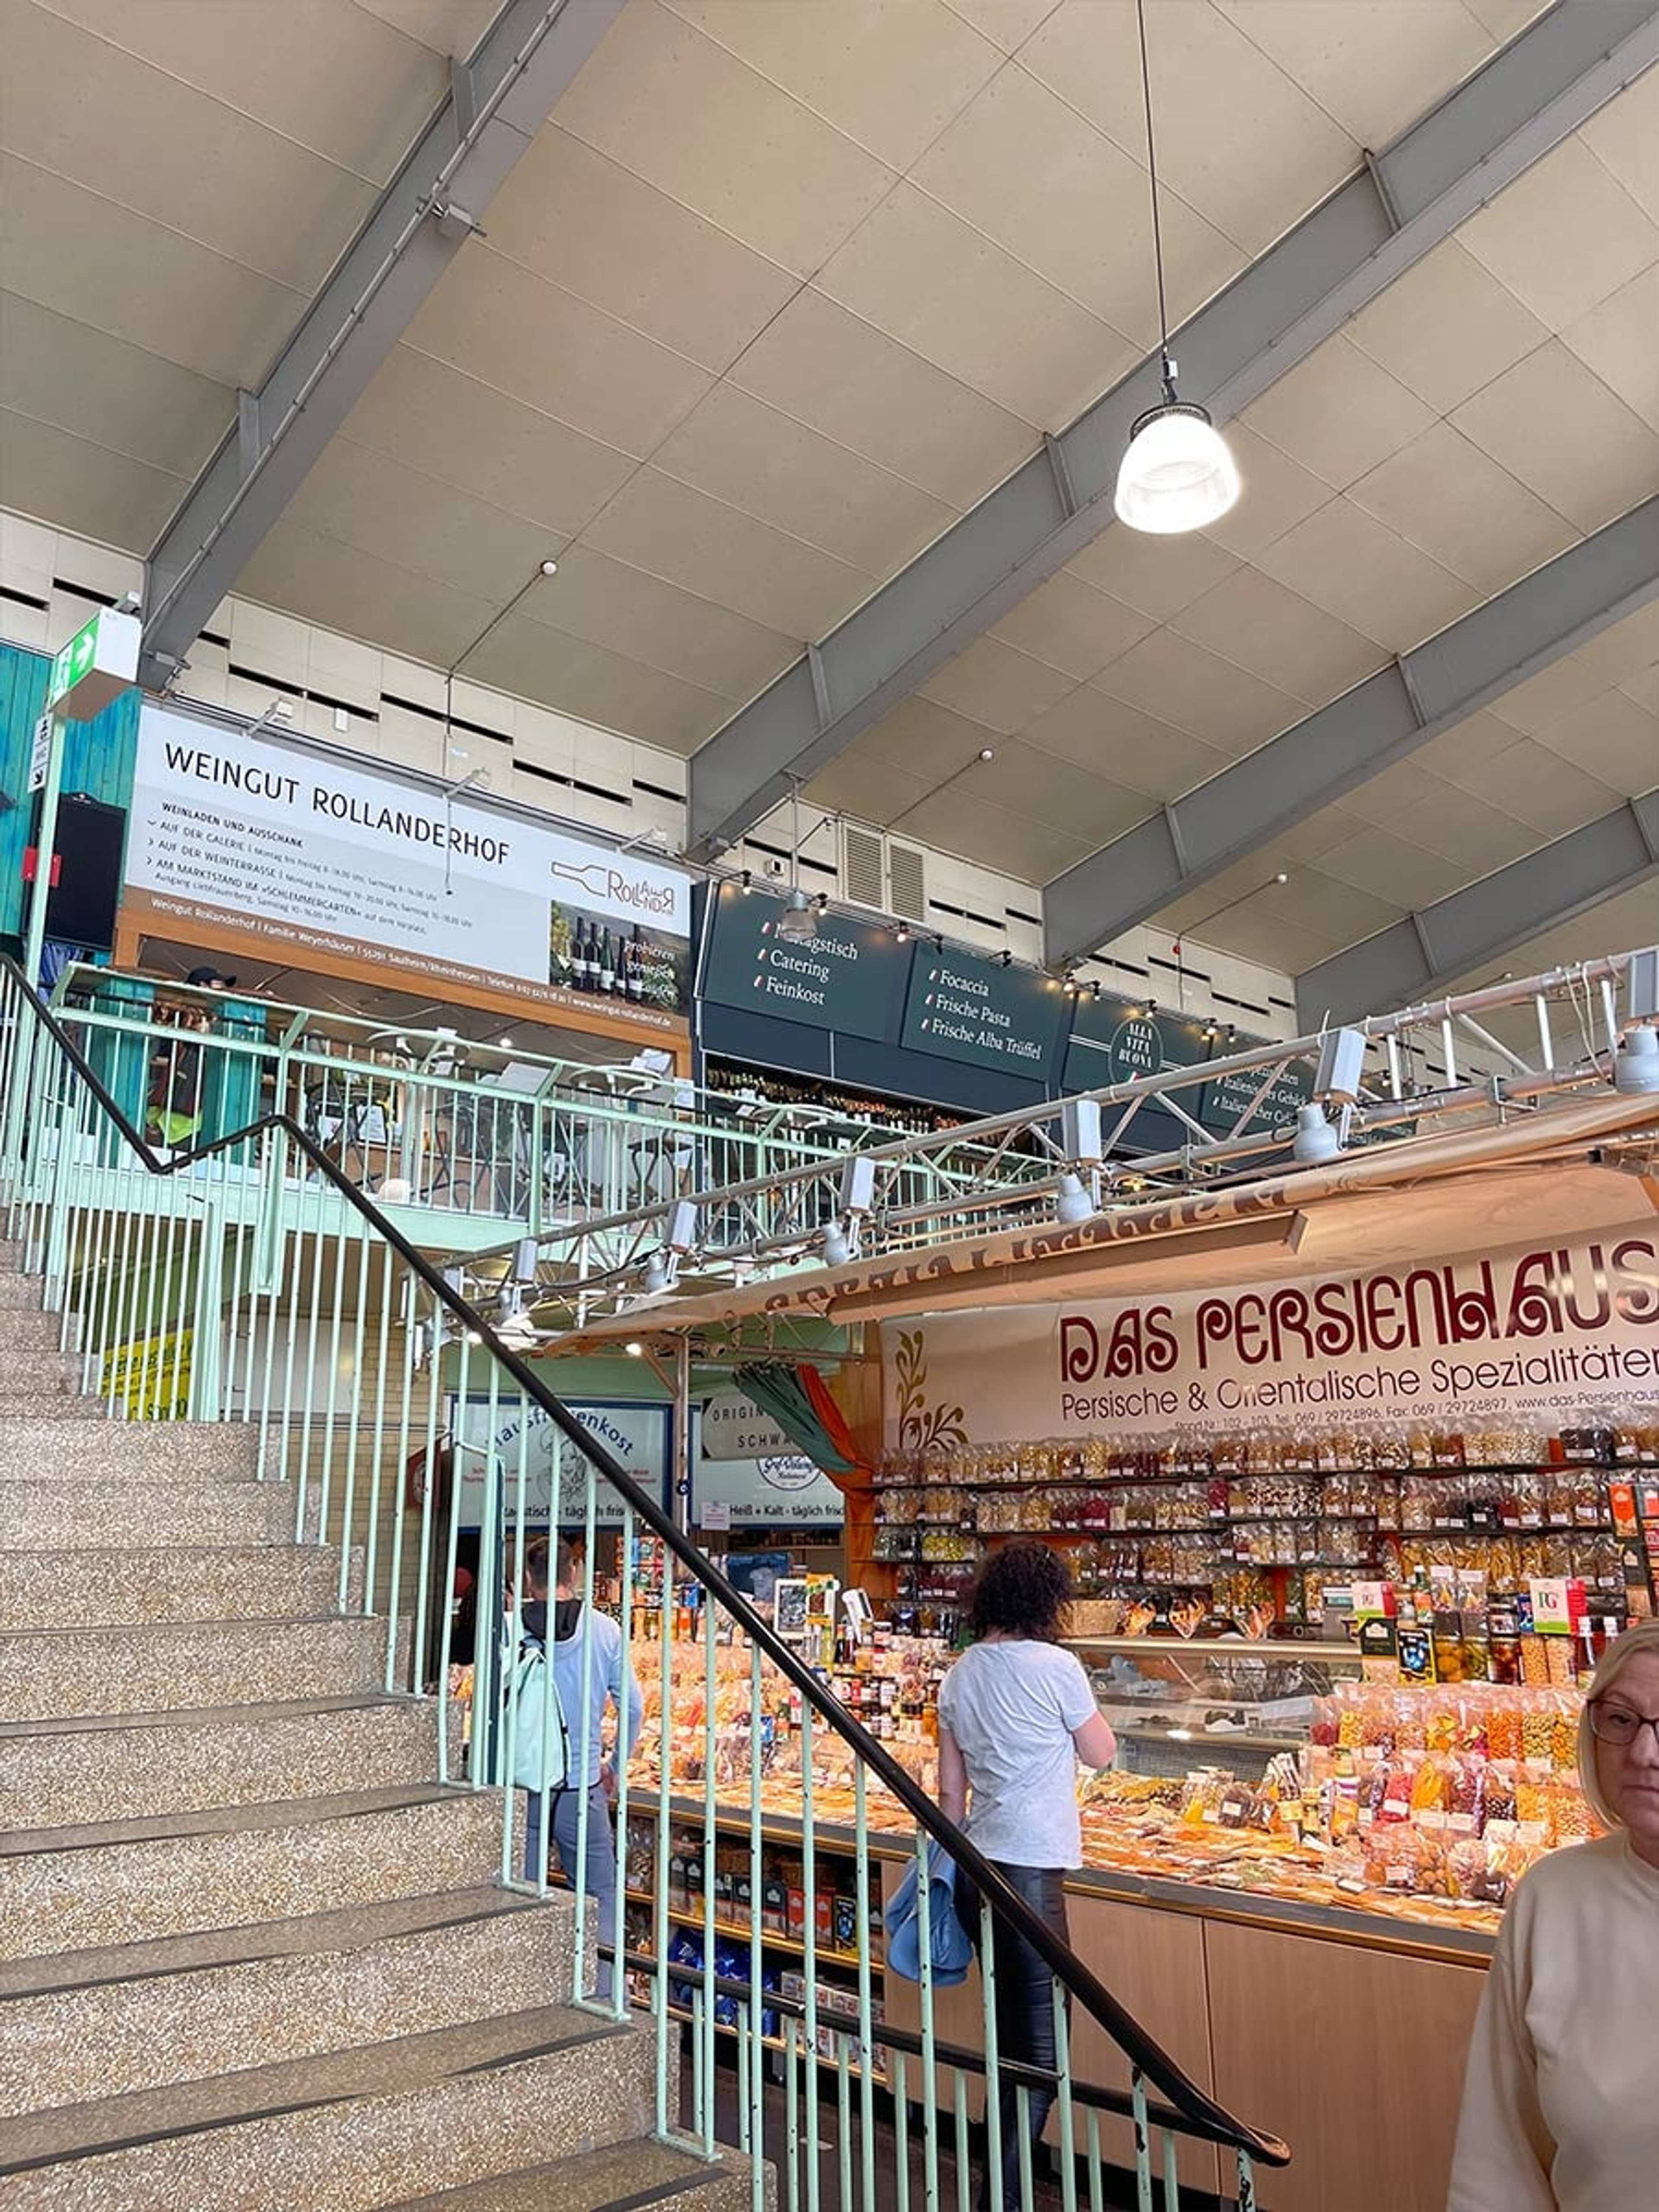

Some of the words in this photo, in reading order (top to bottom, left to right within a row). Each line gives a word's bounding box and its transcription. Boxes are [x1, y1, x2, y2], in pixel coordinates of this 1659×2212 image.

[165, 743, 300, 804] WEINGUT
[313, 787, 510, 864] ROLLANDERHOF
[160, 821, 179, 833] AUF
[183, 826, 203, 839] DER
[206, 833, 245, 851] GALERIE
[162, 801, 220, 826] WEINLADEN
[223, 819, 245, 832] UND
[248, 826, 303, 848] AUSSCHANK
[159, 840, 177, 852] AUF
[181, 845, 202, 857] DER
[204, 851, 275, 878] WEINTERRASSE
[177, 864, 242, 888] MARKTSTAND
[152, 897, 193, 915] Weingut
[770, 949, 830, 983] Catering
[766, 976, 825, 1005] Feinkost
[940, 969, 989, 997] Focaccia
[936, 993, 979, 1019] Frische
[980, 1006, 1011, 1028] Pasta
[932, 1017, 975, 1043] Frische
[976, 1031, 1003, 1050] Alba
[1006, 1037, 1042, 1060] Trüffel
[1060, 1305, 1179, 1383] DAS
[1196, 1239, 1659, 1369] PERSIENHAUS
[1061, 1386, 1178, 1421] Persische
[1188, 1381, 1209, 1413] &
[1217, 1366, 1420, 1410] Orientalische
[1222, 1417, 1241, 1427] 102
[1296, 1411, 1315, 1424] 069
[1412, 1402, 1435, 1416] 069
[730, 1504, 753, 1516] Heiß
[764, 1504, 784, 1516] Kalt
[792, 1503, 823, 1519] täglich
[1538, 1591, 1559, 1610] PG
